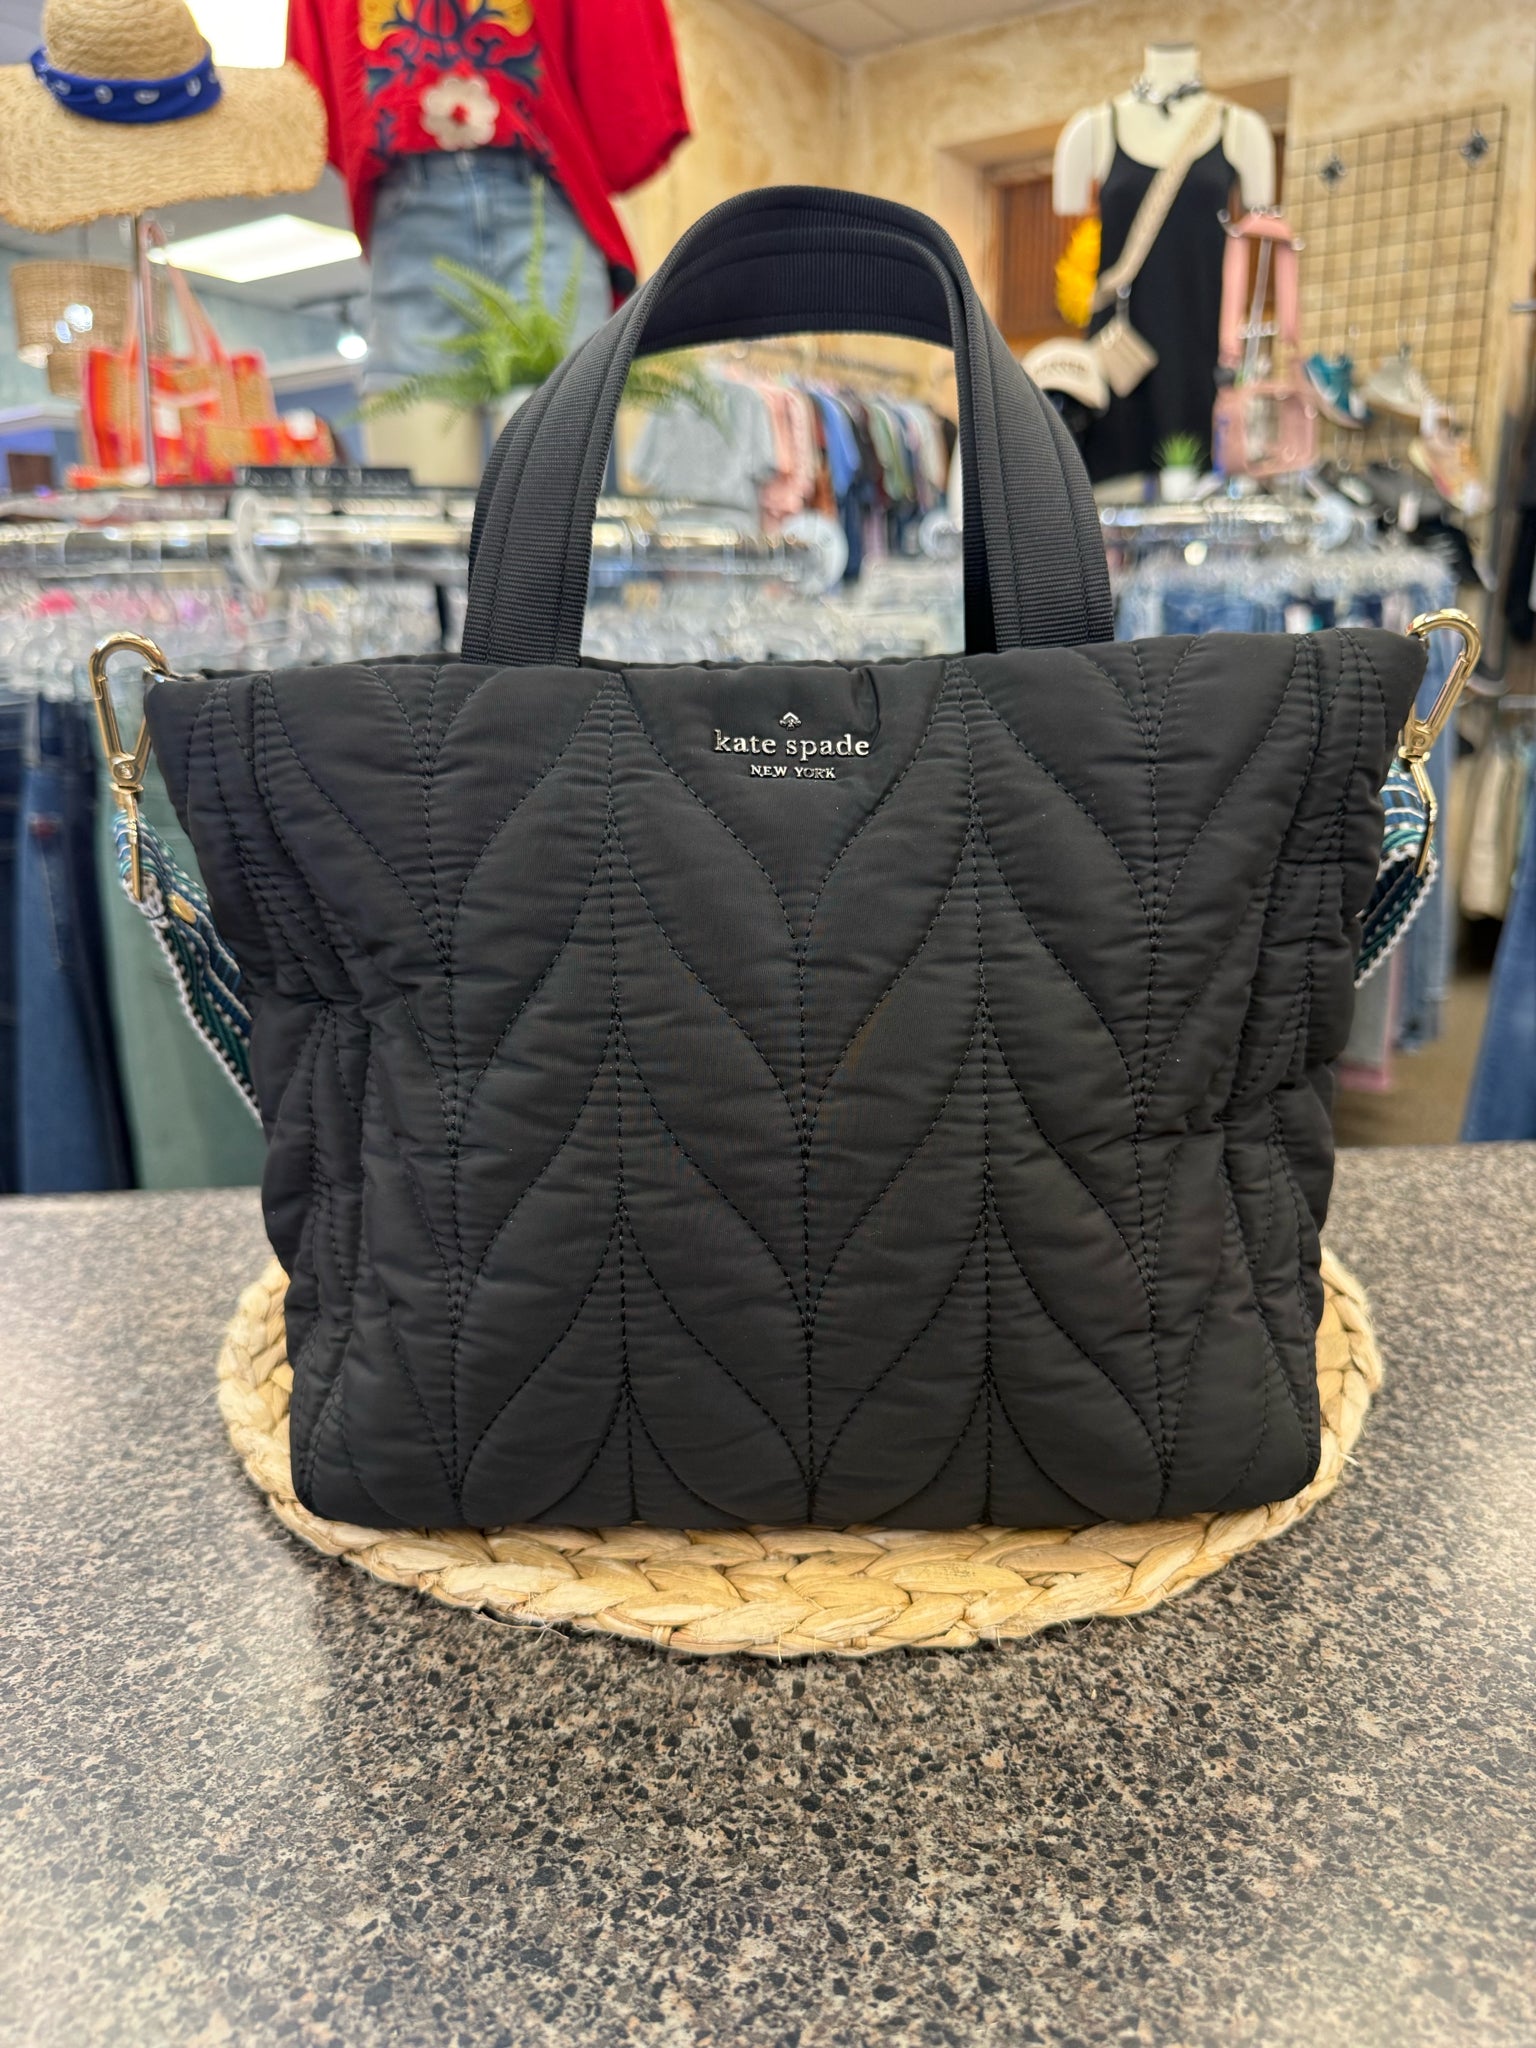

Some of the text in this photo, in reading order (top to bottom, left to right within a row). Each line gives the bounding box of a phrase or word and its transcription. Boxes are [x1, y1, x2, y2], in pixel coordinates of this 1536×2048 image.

[713, 729, 870, 761] kate spade
[750, 764, 836, 779] NEW YORK
